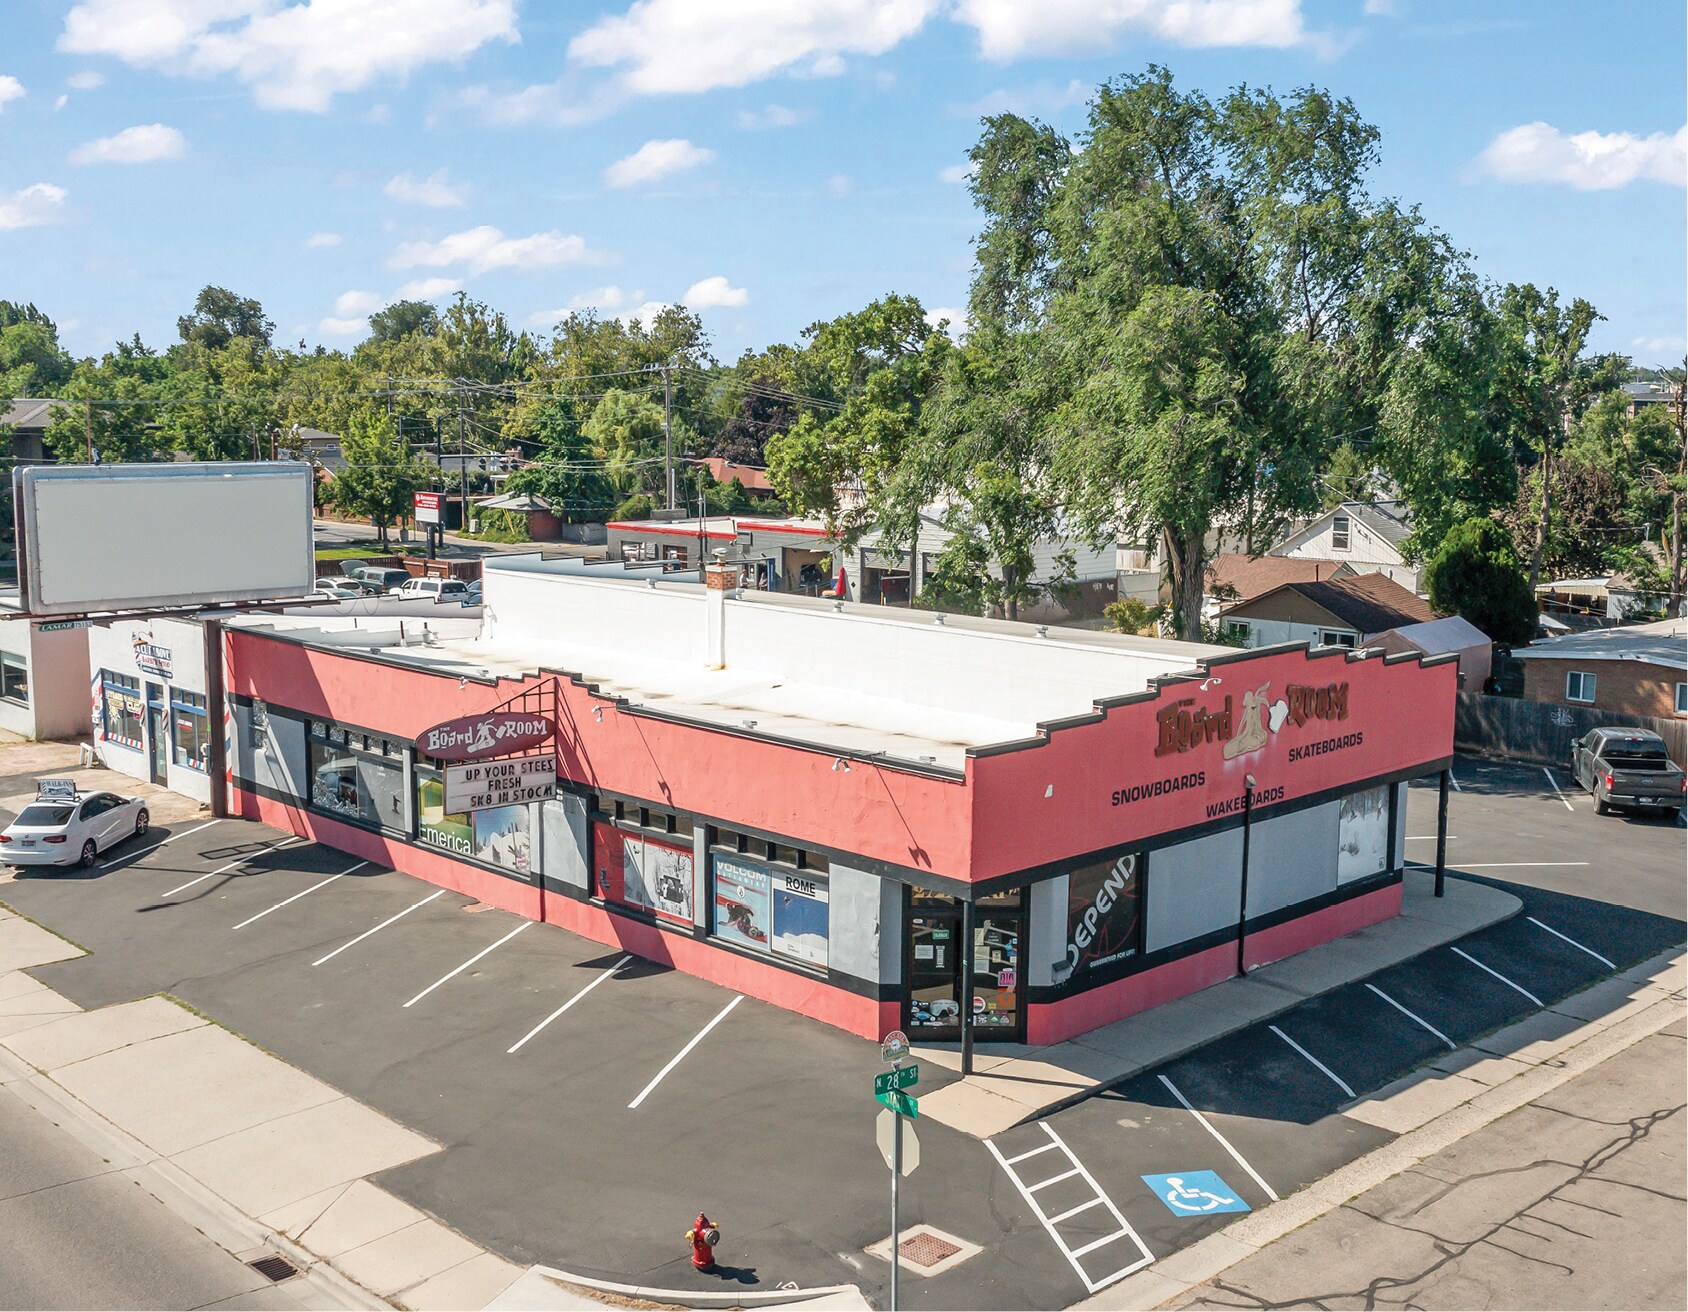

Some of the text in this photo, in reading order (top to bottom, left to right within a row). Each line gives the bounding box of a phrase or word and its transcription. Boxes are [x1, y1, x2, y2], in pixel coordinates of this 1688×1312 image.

[41, 622, 72, 631] LAMAR
[1286, 682, 1350, 728] ROOM
[504, 720, 547, 738] ROOM
[1288, 732, 1363, 762] SKATEBOARDS
[466, 768, 480, 781] UP
[485, 764, 515, 778] YOUR
[488, 777, 521, 791] FRESH
[1111, 771, 1205, 807] SNOWBOARDS
[471, 794, 492, 807] SK8
[498, 792, 509, 803] IN
[716, 860, 766, 882] VOLCOM
[785, 876, 816, 894] ROME
[876, 1077, 882, 1088] N
[909, 1067, 916, 1079] ST
